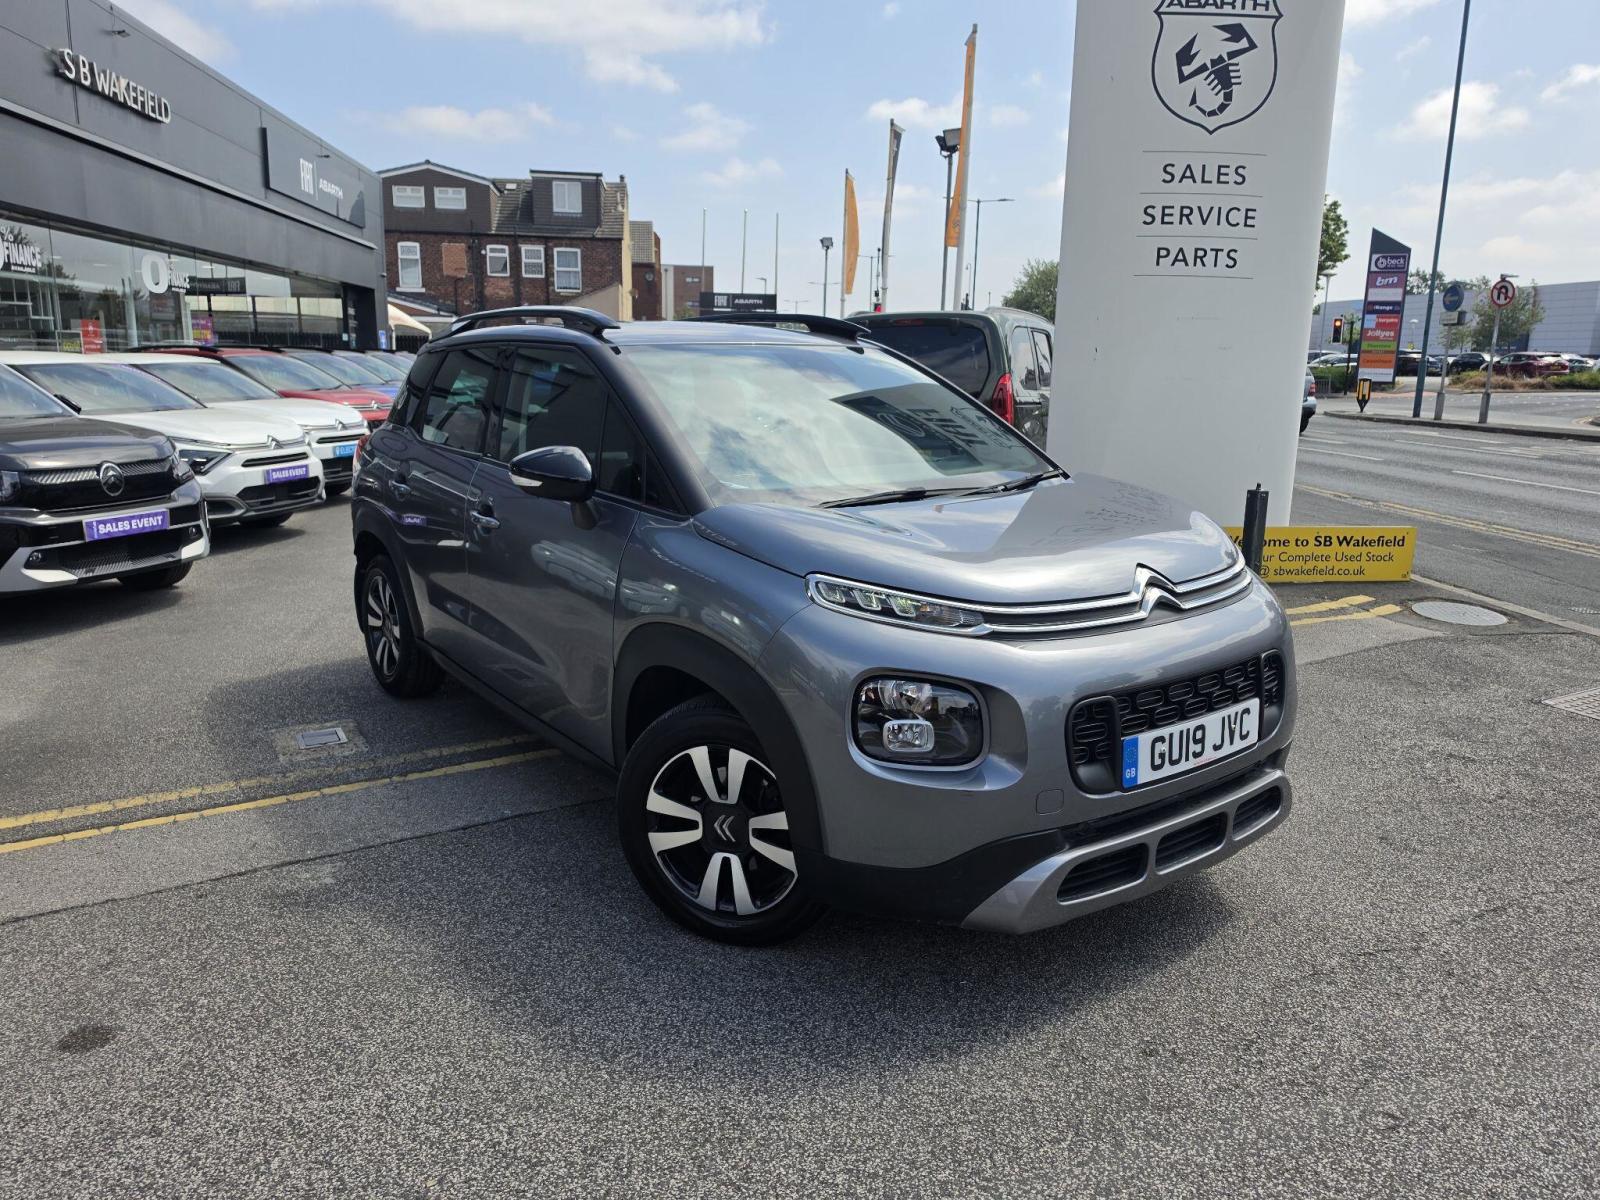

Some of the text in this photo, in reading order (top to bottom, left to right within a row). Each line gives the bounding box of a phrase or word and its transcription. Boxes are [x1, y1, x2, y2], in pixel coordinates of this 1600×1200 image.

[1166, 0, 1270, 11] ABARTH
[93, 61, 171, 124] WAKEFIELD
[300, 158, 343, 199] FIAT ABARTH
[1161, 163, 1247, 185] SALES
[1142, 205, 1257, 228] SERVICE
[4, 241, 42, 267] FINANCE
[1155, 246, 1238, 269] PARTS
[714, 295, 728, 307] FIAT
[272, 470, 289, 479] SALES
[289, 467, 306, 476] EVENT
[98, 520, 130, 534] SALES
[131, 516, 163, 529] EVENT
[1295, 537, 1309, 547] to
[1314, 536, 1332, 547] SB
[1337, 535, 1405, 547] Wakefield
[1262, 552, 1394, 564] ur Complete Used Stock
[1274, 565, 1365, 576] sbwakefield.co.uk
[1150, 707, 1250, 771] GU19 JVC
[1125, 767, 1136, 778] GB
